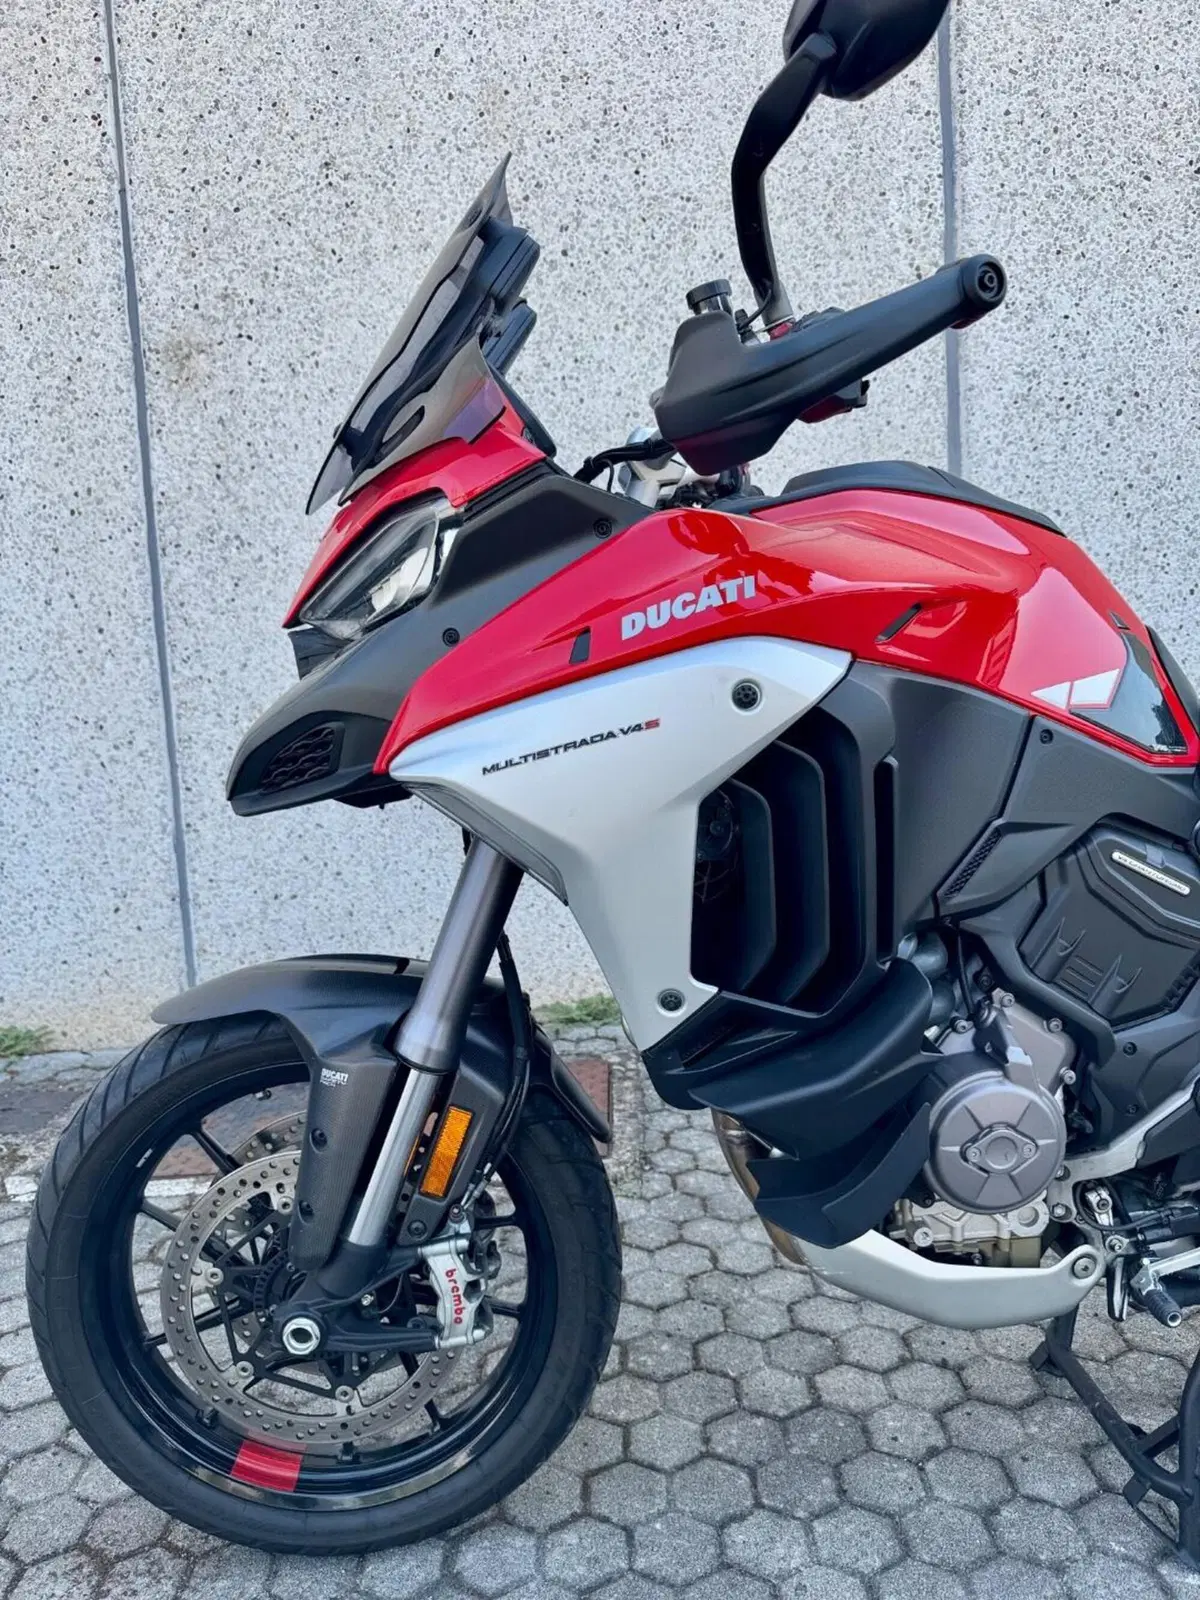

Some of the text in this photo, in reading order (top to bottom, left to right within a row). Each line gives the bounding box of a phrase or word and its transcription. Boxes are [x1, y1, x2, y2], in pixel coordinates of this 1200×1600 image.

[621, 575, 756, 641] DUCATI
[482, 718, 661, 776] MULTISTRADA V4S
[445, 1268, 466, 1324] brembo
